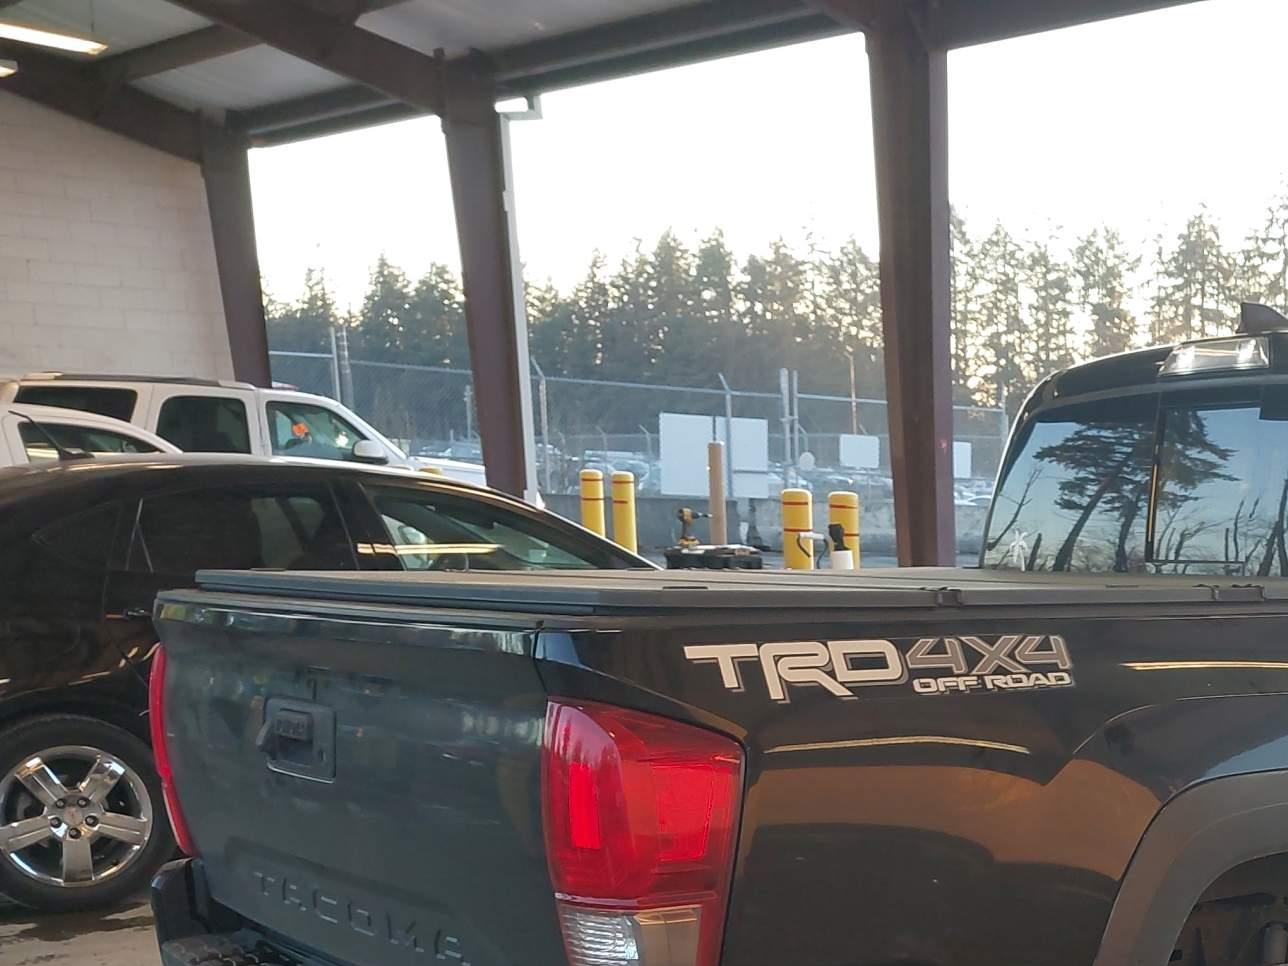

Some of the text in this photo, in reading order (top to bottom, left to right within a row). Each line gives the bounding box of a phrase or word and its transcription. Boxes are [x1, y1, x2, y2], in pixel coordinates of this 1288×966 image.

[684, 635, 1072, 702] TRD 4X4
[912, 671, 1075, 694] OFF ROAD
